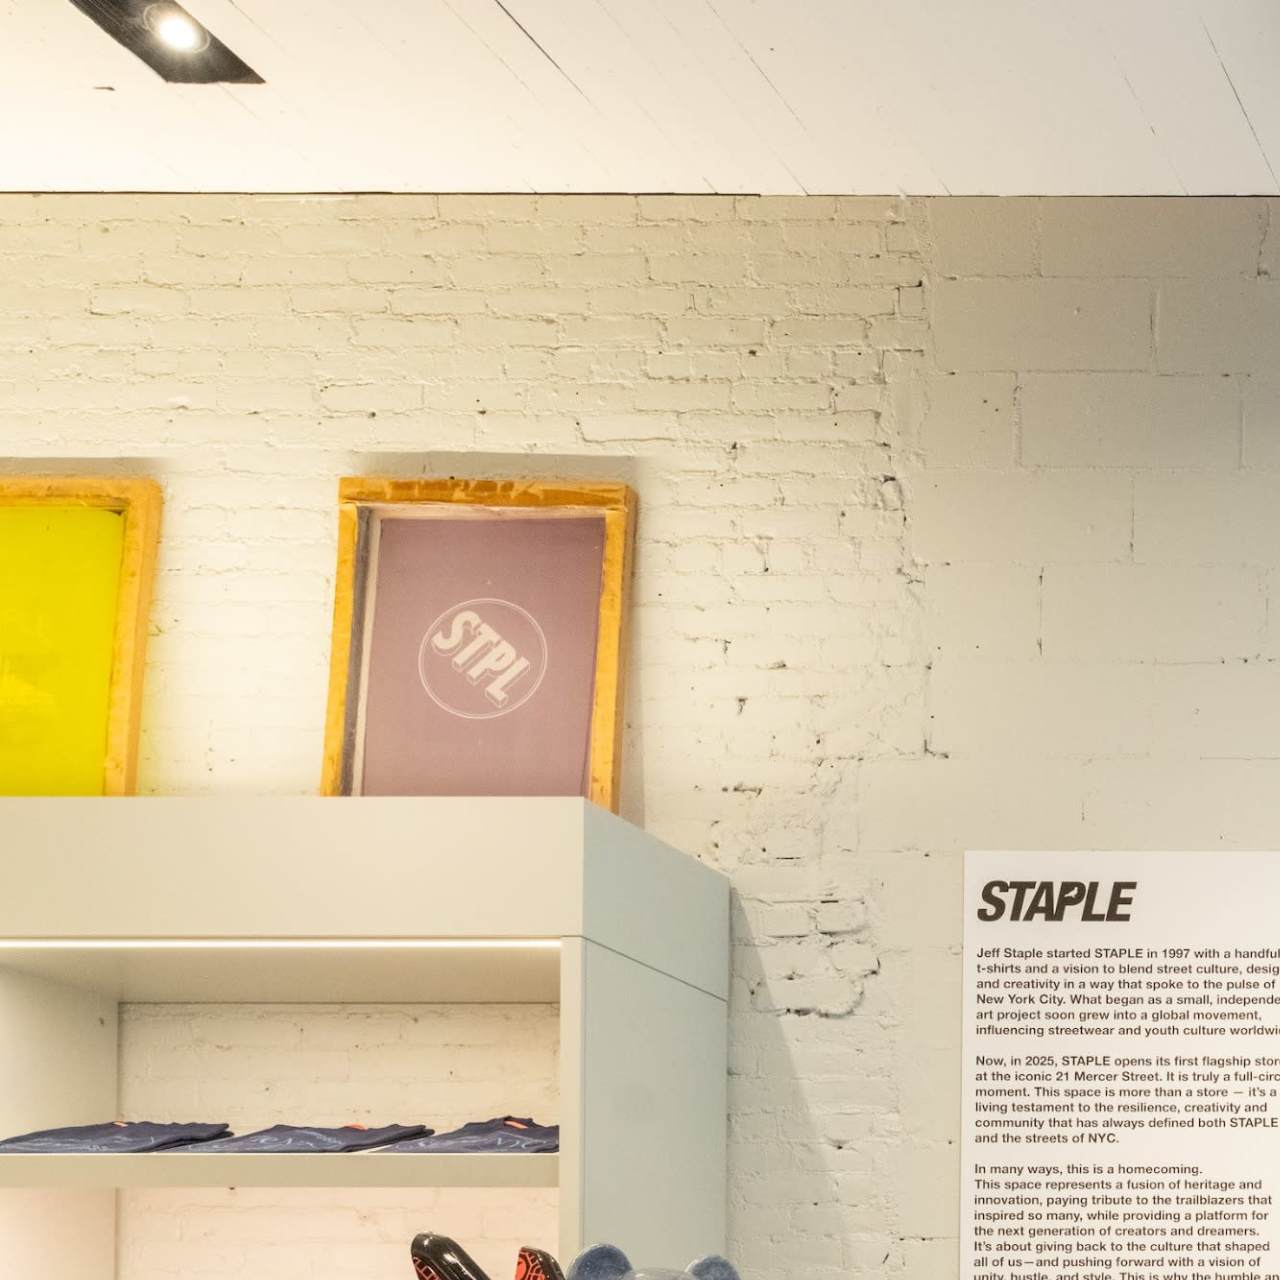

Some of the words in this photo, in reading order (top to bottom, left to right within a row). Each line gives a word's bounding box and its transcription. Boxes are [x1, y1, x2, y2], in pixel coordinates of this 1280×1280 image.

[431, 610, 531, 708] STPL
[977, 880, 1138, 922] STAPLE
[976, 947, 1000, 958] Jeff
[1004, 947, 1043, 960] Staple
[1046, 948, 1091, 959] started
[1094, 948, 1144, 959] STAPLE
[1147, 948, 1158, 959] in
[1162, 948, 1190, 959] 1997
[1194, 948, 1220, 959] with
[1223, 951, 1231, 959] a
[1234, 948, 1280, 959] handful
[977, 963, 1021, 974] t-shirts
[1025, 964, 1048, 974] and
[1051, 966, 1059, 974] a
[1063, 964, 1099, 974] vision
[1103, 964, 1115, 974] to
[1119, 964, 1153, 974] blend
[1157, 964, 1192, 974] street
[1196, 964, 1242, 975] culture,
[976, 979, 1000, 989] and
[1003, 979, 1060, 991] creativity
[1064, 979, 1075, 989] in
[1078, 981, 1086, 989] a
[1089, 981, 1115, 991] way
[1118, 979, 1142, 989] that
[1146, 979, 1183, 991] spoke
[1187, 980, 1199, 989] to
[1203, 979, 1223, 989] the
[1226, 979, 1260, 991] pulse
[1263, 979, 1276, 989] of
[976, 994, 1004, 1004] New
[1008, 994, 1035, 1004] York
[1039, 994, 1066, 1007] City.
[1070, 994, 1102, 1005] What
[1105, 994, 1144, 1007] began
[1147, 997, 1162, 1005] as
[1165, 997, 1173, 1005] a
[1176, 994, 1213, 1006] small,
[976, 1010, 993, 1020] art
[997, 1010, 1041, 1022] project
[1044, 1012, 1075, 1020] soon
[1079, 1012, 1110, 1022] grew
[1113, 1010, 1137, 1020] into
[1140, 1012, 1148, 1020] a
[1151, 1010, 1190, 1022] global
[1193, 1010, 1262, 1021] movement,
[976, 1025, 1044, 1038] influencing
[1048, 1025, 1115, 1035] streetwear
[1118, 1025, 1141, 1035] and
[1144, 1025, 1179, 1038] youth
[1183, 1025, 1226, 1035] culture
[976, 1055, 1007, 1067] Now,
[1011, 1056, 1021, 1066] in
[1025, 1056, 1058, 1067] 2025,
[1061, 1056, 1111, 1066] STAPLE
[1114, 1058, 1152, 1068] opens
[1156, 1056, 1171, 1066] its
[1174, 1056, 1198, 1066] first
[1202, 1056, 1251, 1068] flagship
[975, 1071, 988, 1081] at
[991, 1071, 1011, 1081] the
[1014, 1071, 1052, 1081] iconic
[1056, 1071, 1069, 1081] 21
[1074, 1071, 1119, 1082] Mercer
[1122, 1071, 1163, 1082] Street.
[1166, 1071, 1175, 1082] It
[1178, 1071, 1189, 1082] is
[1192, 1071, 1220, 1084] truly
[1223, 1073, 1231, 1081] a
[975, 1087, 1030, 1097] moment.
[1034, 1086, 1060, 1097] This
[1064, 1089, 1101, 1099] space
[1105, 1087, 1116, 1097] is
[1119, 1089, 1151, 1097] more
[1155, 1087, 1182, 1097] than
[1185, 1089, 1193, 1097] a
[1196, 1087, 1228, 1097] store
[1249, 1087, 1266, 1097] it’s
[1269, 1089, 1277, 1097] a
[975, 1102, 1008, 1114] living
[1011, 1102, 1074, 1112] testament
[1078, 1103, 1091, 1112] to
[1094, 1102, 1114, 1112] the
[1117, 1102, 1180, 1114] resilience,
[1184, 1102, 1241, 1114] creativity
[1244, 1102, 1267, 1113] and
